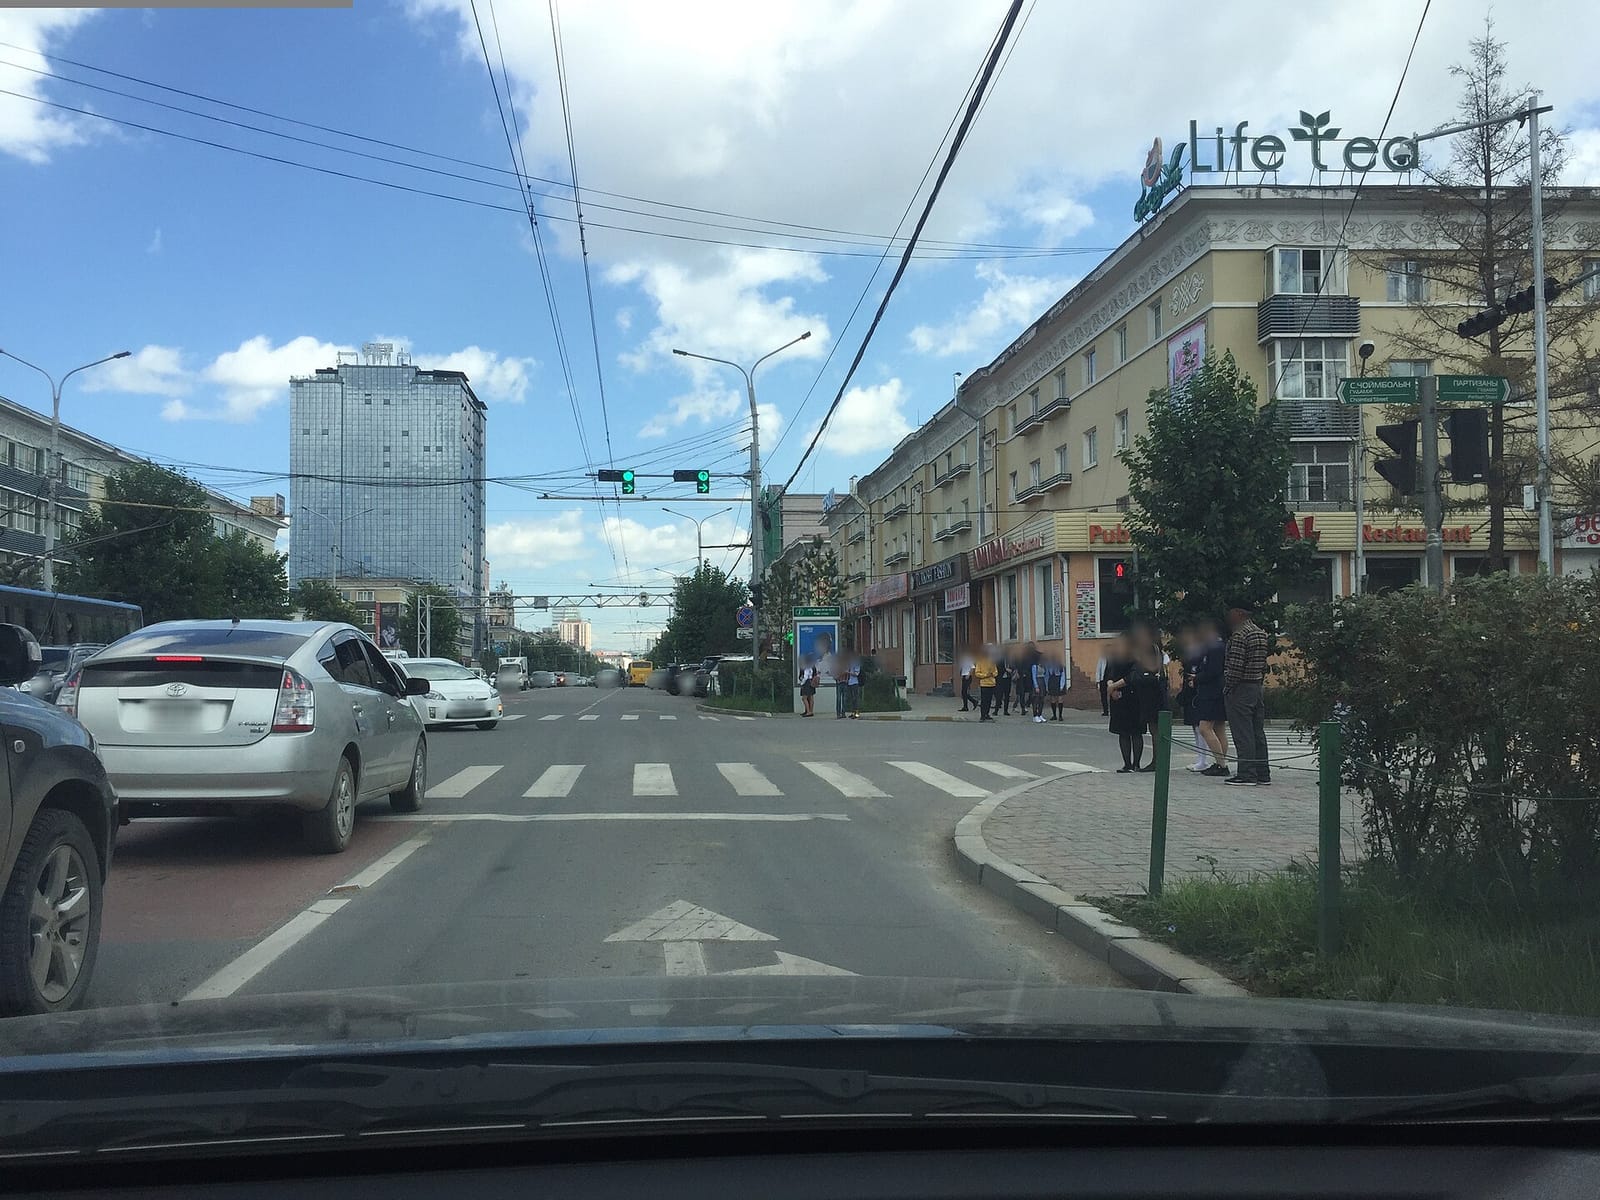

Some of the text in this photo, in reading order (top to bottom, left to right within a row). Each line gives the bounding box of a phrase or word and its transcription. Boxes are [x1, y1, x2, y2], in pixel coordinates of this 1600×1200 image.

[1190, 110, 1419, 173] Life tea
[1453, 379, 1498, 387] ПАРТИЗАНЫ
[1089, 523, 1130, 544] Pub
[1363, 524, 1472, 542] Restauant
